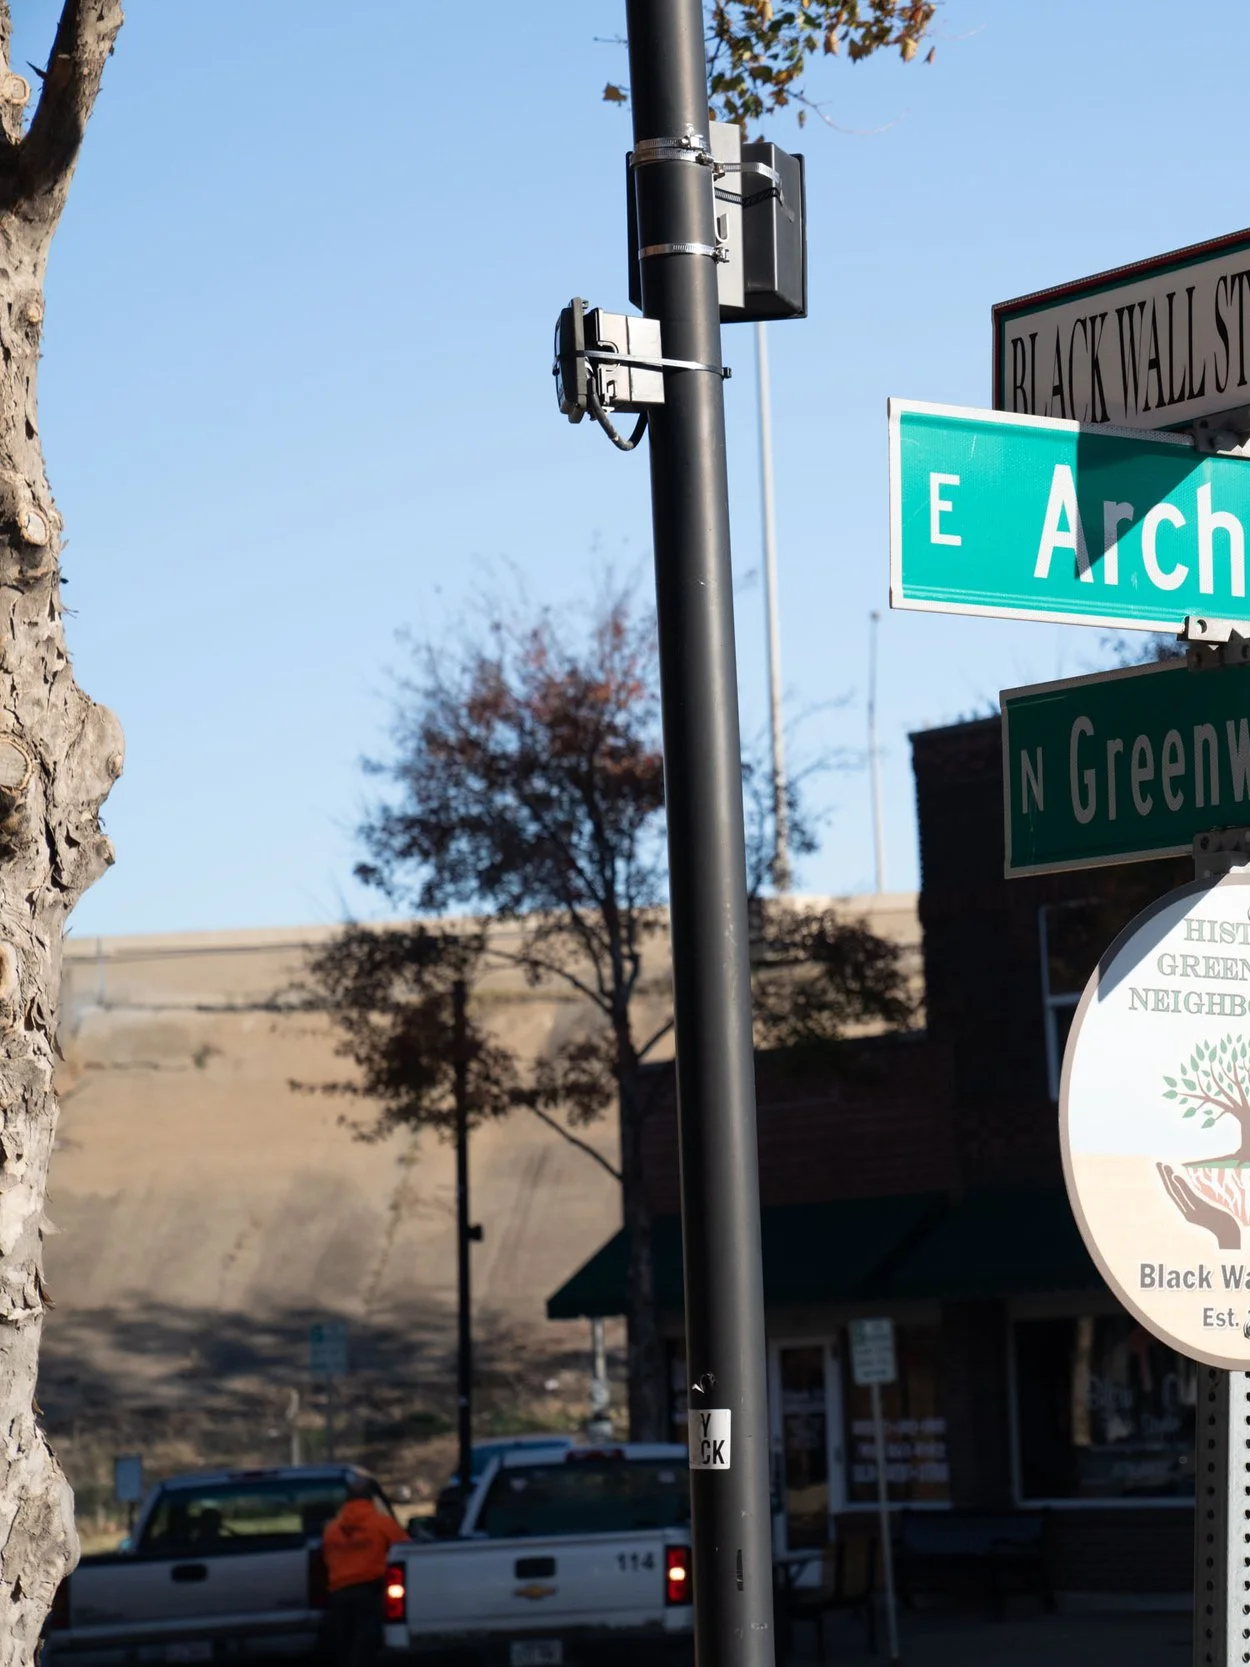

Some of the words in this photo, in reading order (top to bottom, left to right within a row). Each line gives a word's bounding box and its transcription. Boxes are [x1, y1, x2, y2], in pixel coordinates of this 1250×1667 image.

[1010, 311, 1111, 423] BLACK
[1115, 286, 1207, 419] WALL
[929, 471, 963, 547] E
[1020, 746, 1045, 815] N
[1139, 1262, 1213, 1290] Black
[1203, 1307, 1239, 1327] Est.
[616, 1552, 655, 1572] 114
